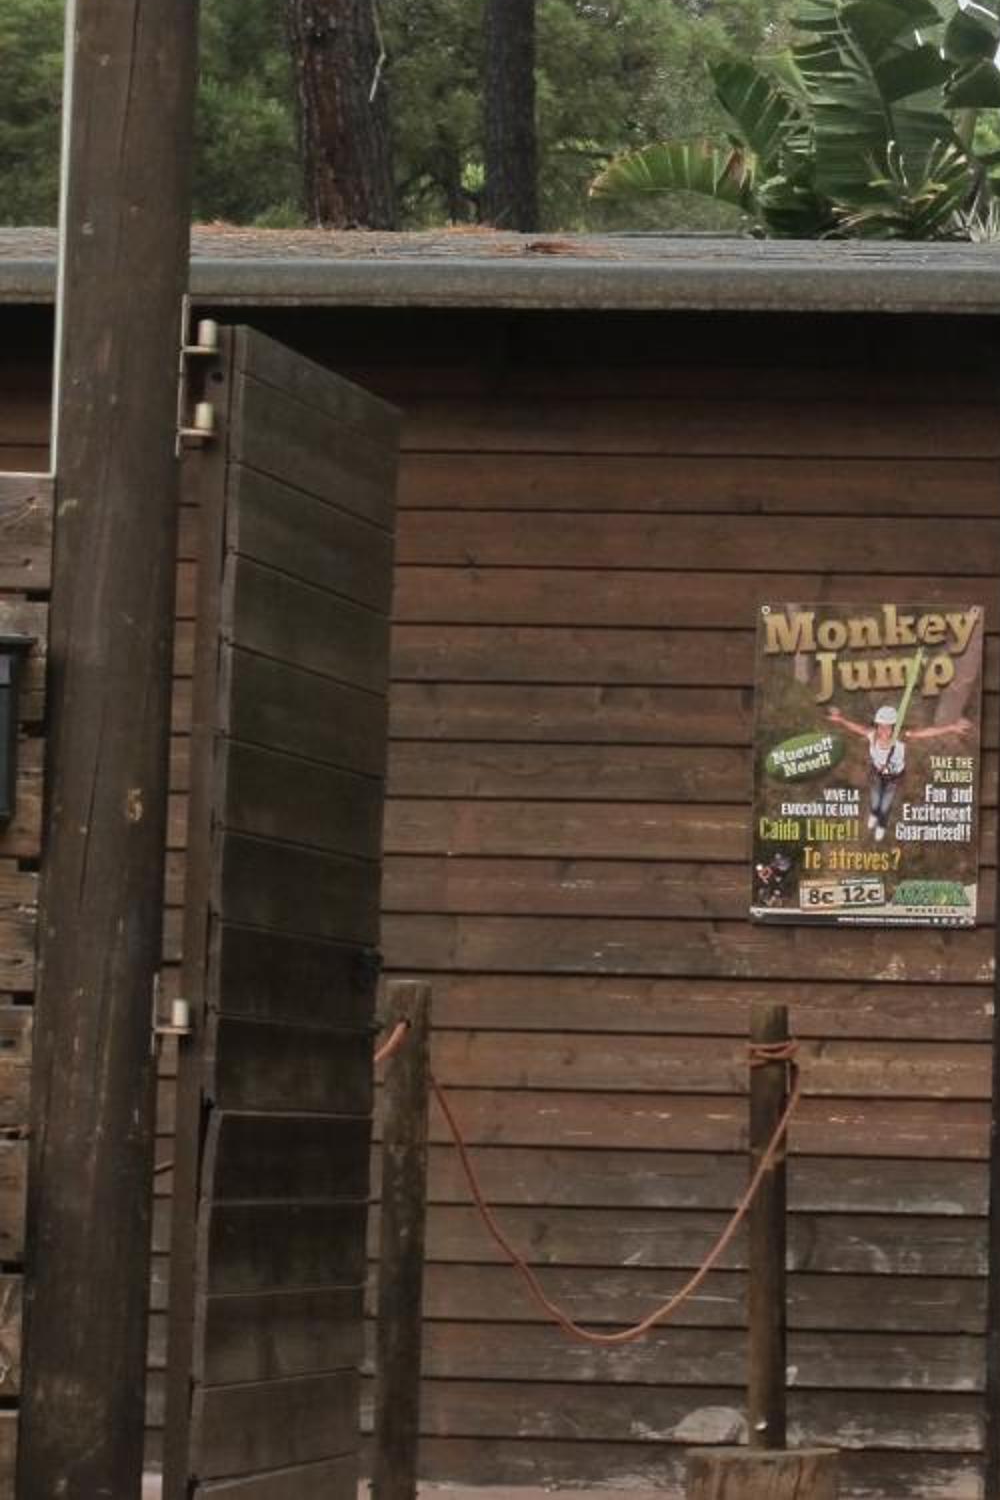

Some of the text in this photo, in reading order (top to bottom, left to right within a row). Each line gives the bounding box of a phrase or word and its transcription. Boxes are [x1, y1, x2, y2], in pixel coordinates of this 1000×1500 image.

[763, 603, 980, 654] Monkey
[816, 652, 955, 703] Jump
[903, 803, 972, 822] Excitement
[803, 847, 821, 869] Te
